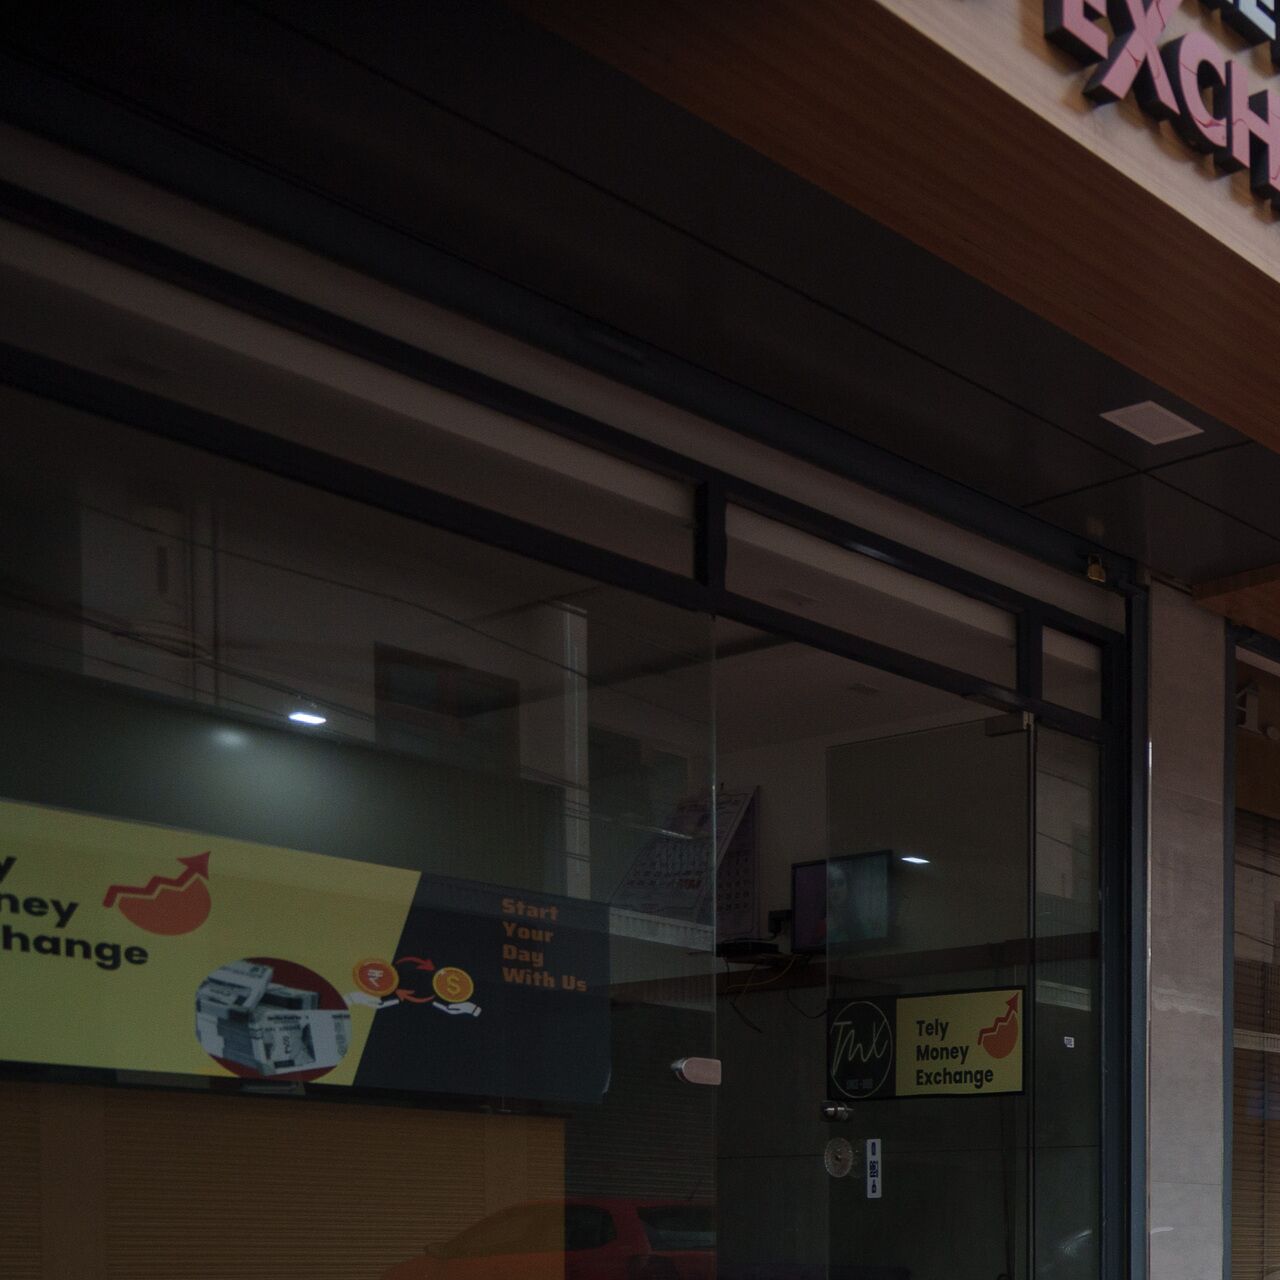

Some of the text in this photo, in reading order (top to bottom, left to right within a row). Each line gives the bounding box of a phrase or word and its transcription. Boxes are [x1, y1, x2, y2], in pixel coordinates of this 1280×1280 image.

[501, 897, 559, 921] Start
[502, 921, 554, 943] Your
[502, 943, 544, 969] Day
[501, 966, 589, 992] With Us
[916, 1018, 949, 1041] Tely
[916, 1044, 969, 1065] Money
[916, 1066, 994, 1089] Exchange
